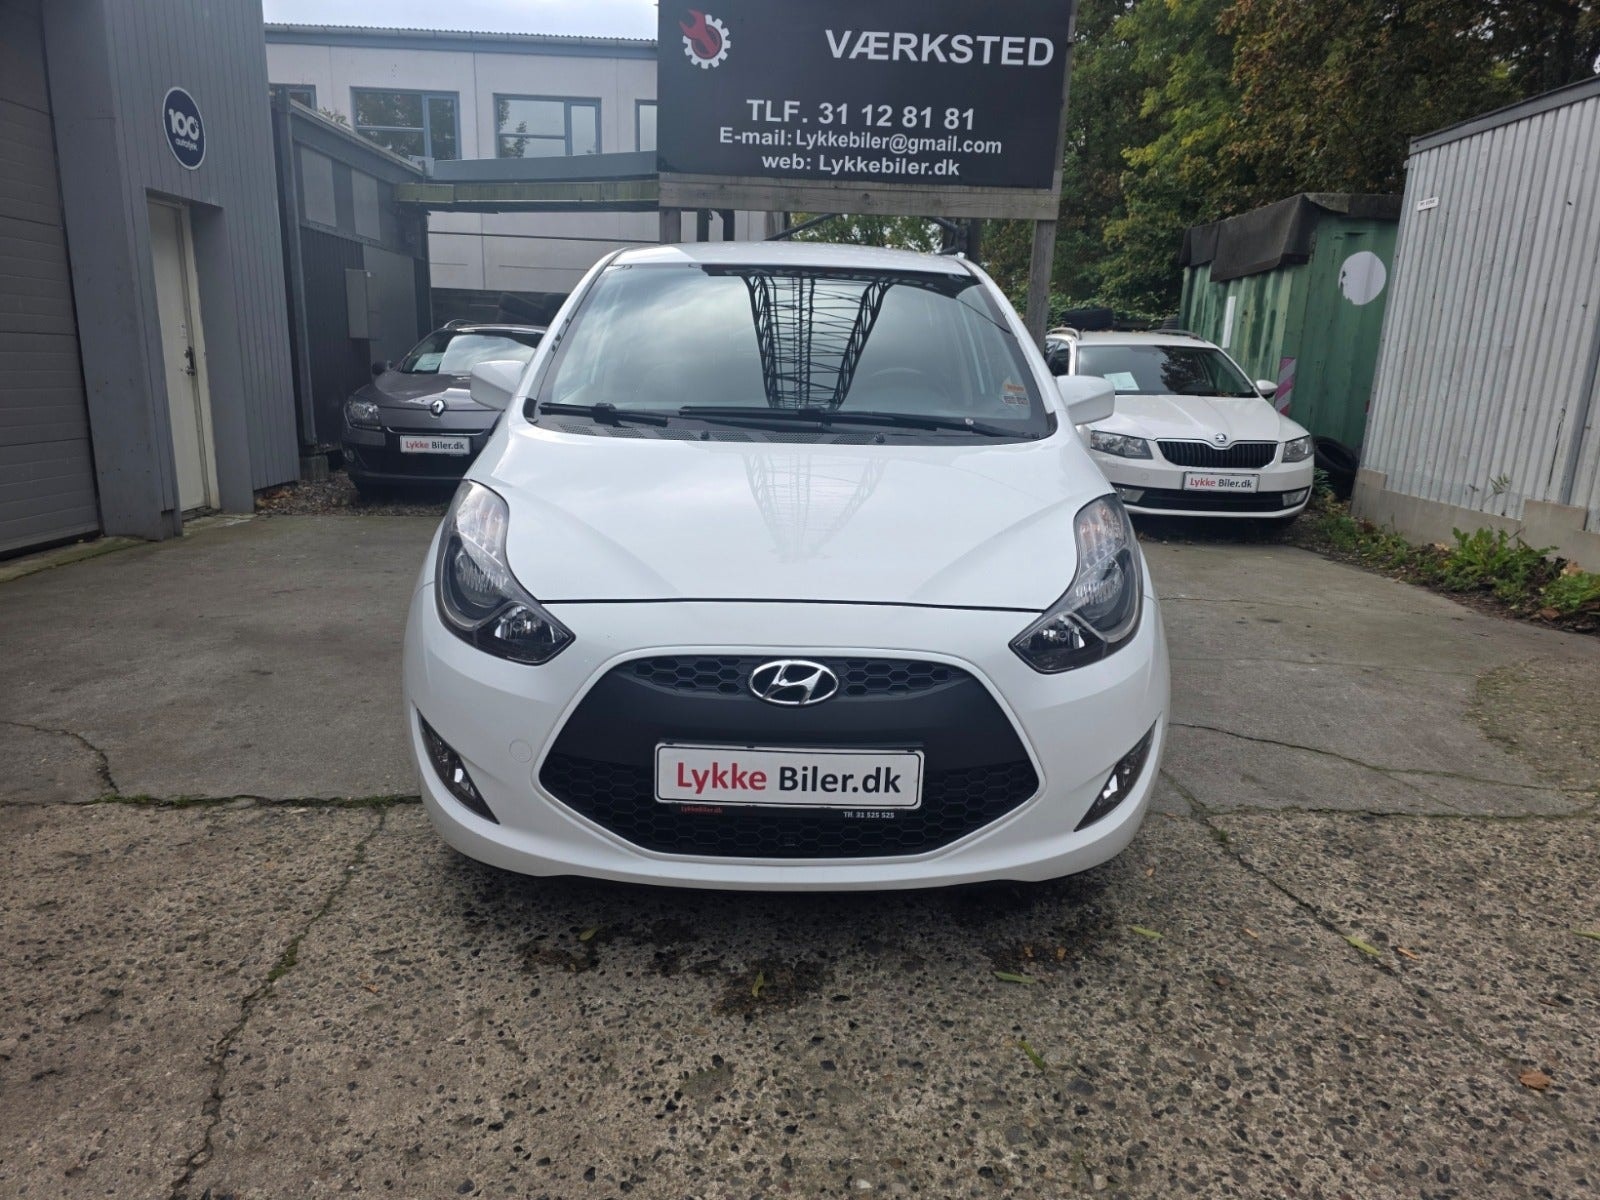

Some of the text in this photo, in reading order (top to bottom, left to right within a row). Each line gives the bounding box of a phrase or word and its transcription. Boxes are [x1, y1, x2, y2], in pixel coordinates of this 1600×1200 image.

[824, 29, 1055, 67] VÆRKSTED
[746, 99, 974, 131] TLF. 31 12 81 81
[719, 127, 1002, 155] E-mail: Lykkebiler@gmail.com
[762, 154, 960, 176] web: Lykkebiler.dk
[405, 440, 465, 450] Lykke Biler.dk
[1189, 477, 1252, 489] Lykke Biler.dk
[677, 761, 901, 794] Lykke Biler.dk
